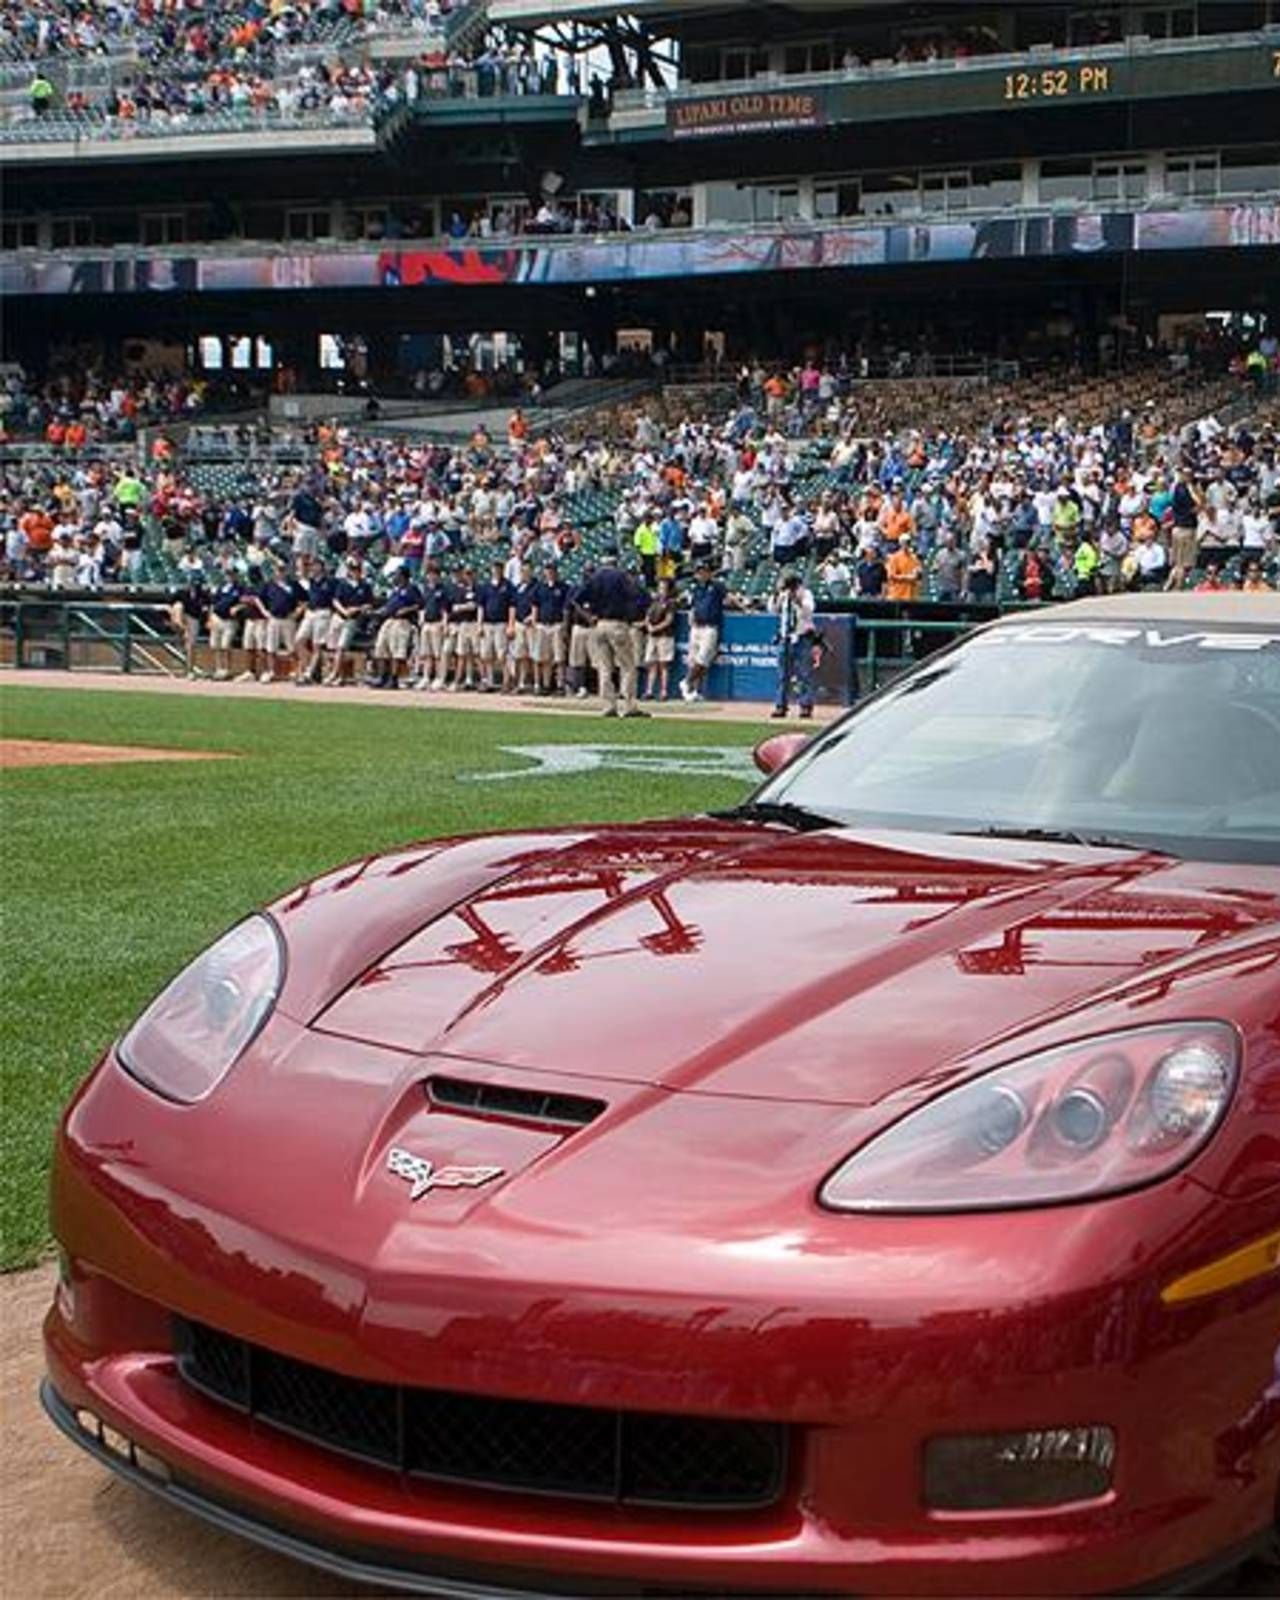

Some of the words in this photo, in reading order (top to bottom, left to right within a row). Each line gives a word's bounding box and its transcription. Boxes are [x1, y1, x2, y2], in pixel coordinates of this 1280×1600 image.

[1004, 70, 1069, 99] 12:52
[1079, 66, 1109, 92] PM
[730, 96, 764, 116] OLD
